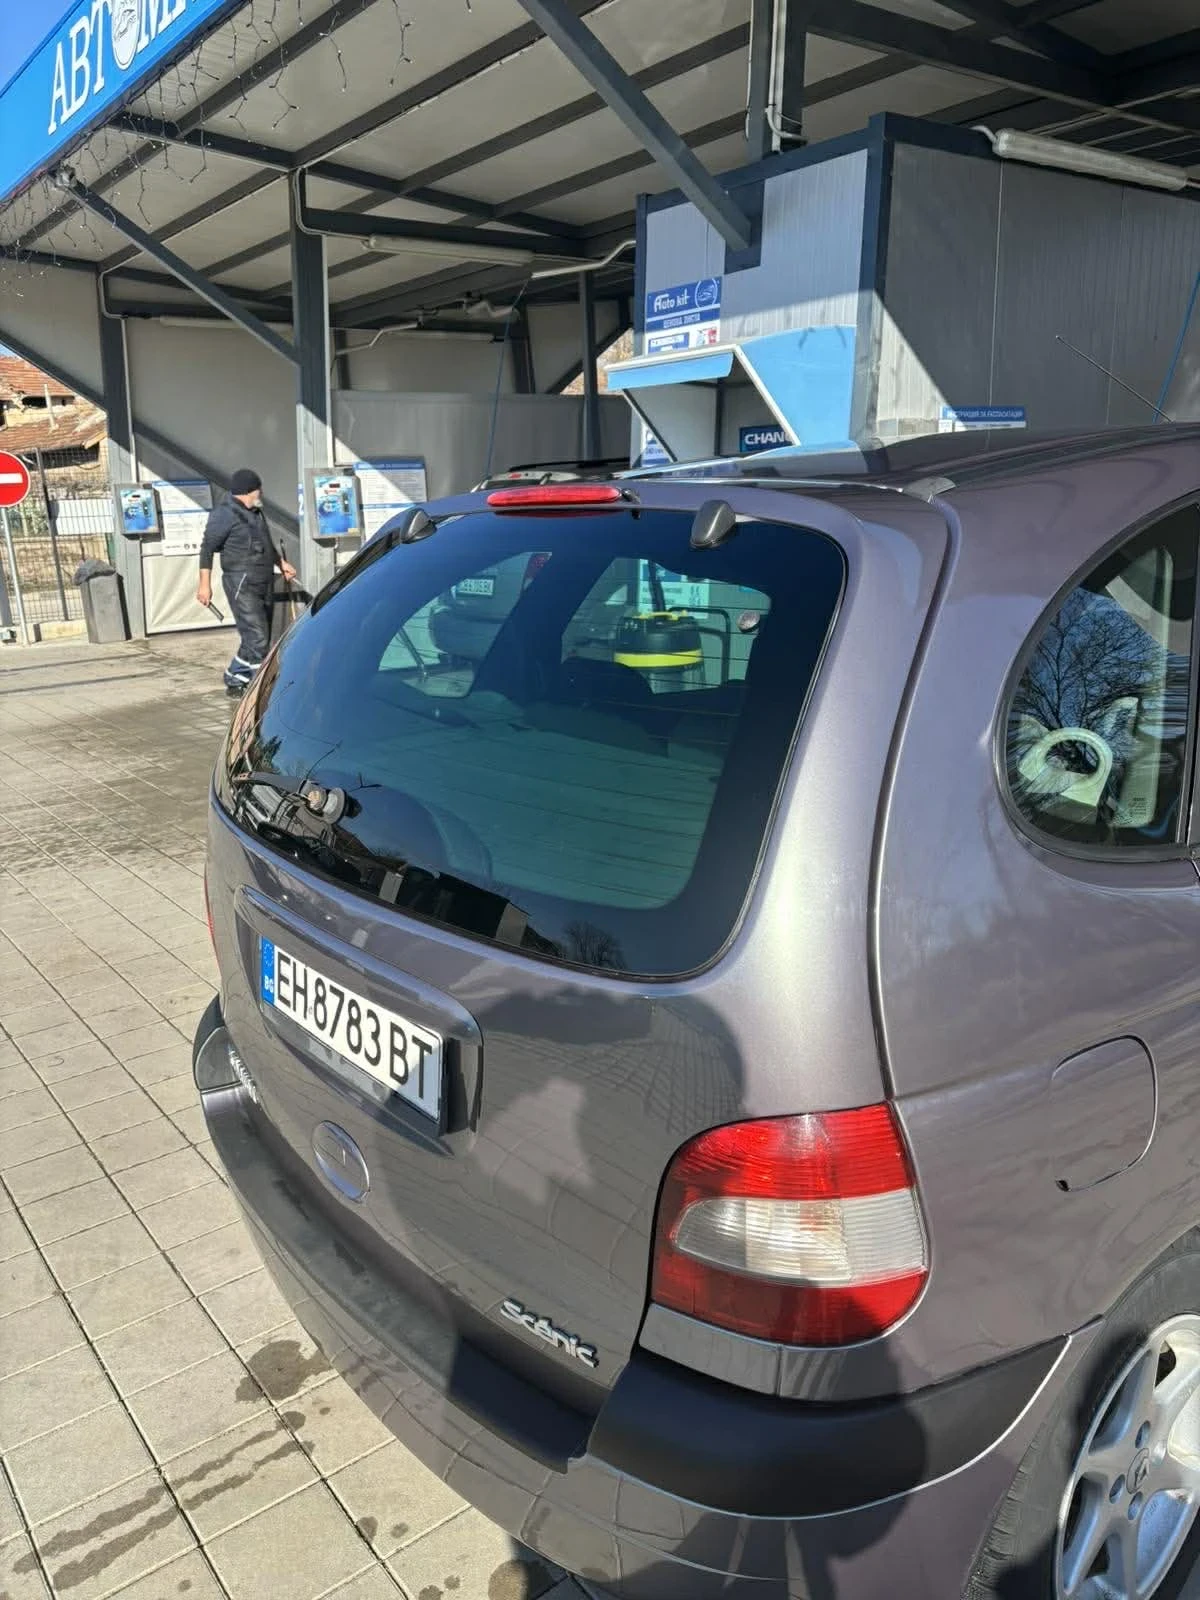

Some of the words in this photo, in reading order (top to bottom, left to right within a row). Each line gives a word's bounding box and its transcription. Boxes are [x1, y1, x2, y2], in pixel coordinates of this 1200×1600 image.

[654, 293, 676, 313] Auto
[676, 288, 690, 307] kit
[264, 975, 275, 994] BG
